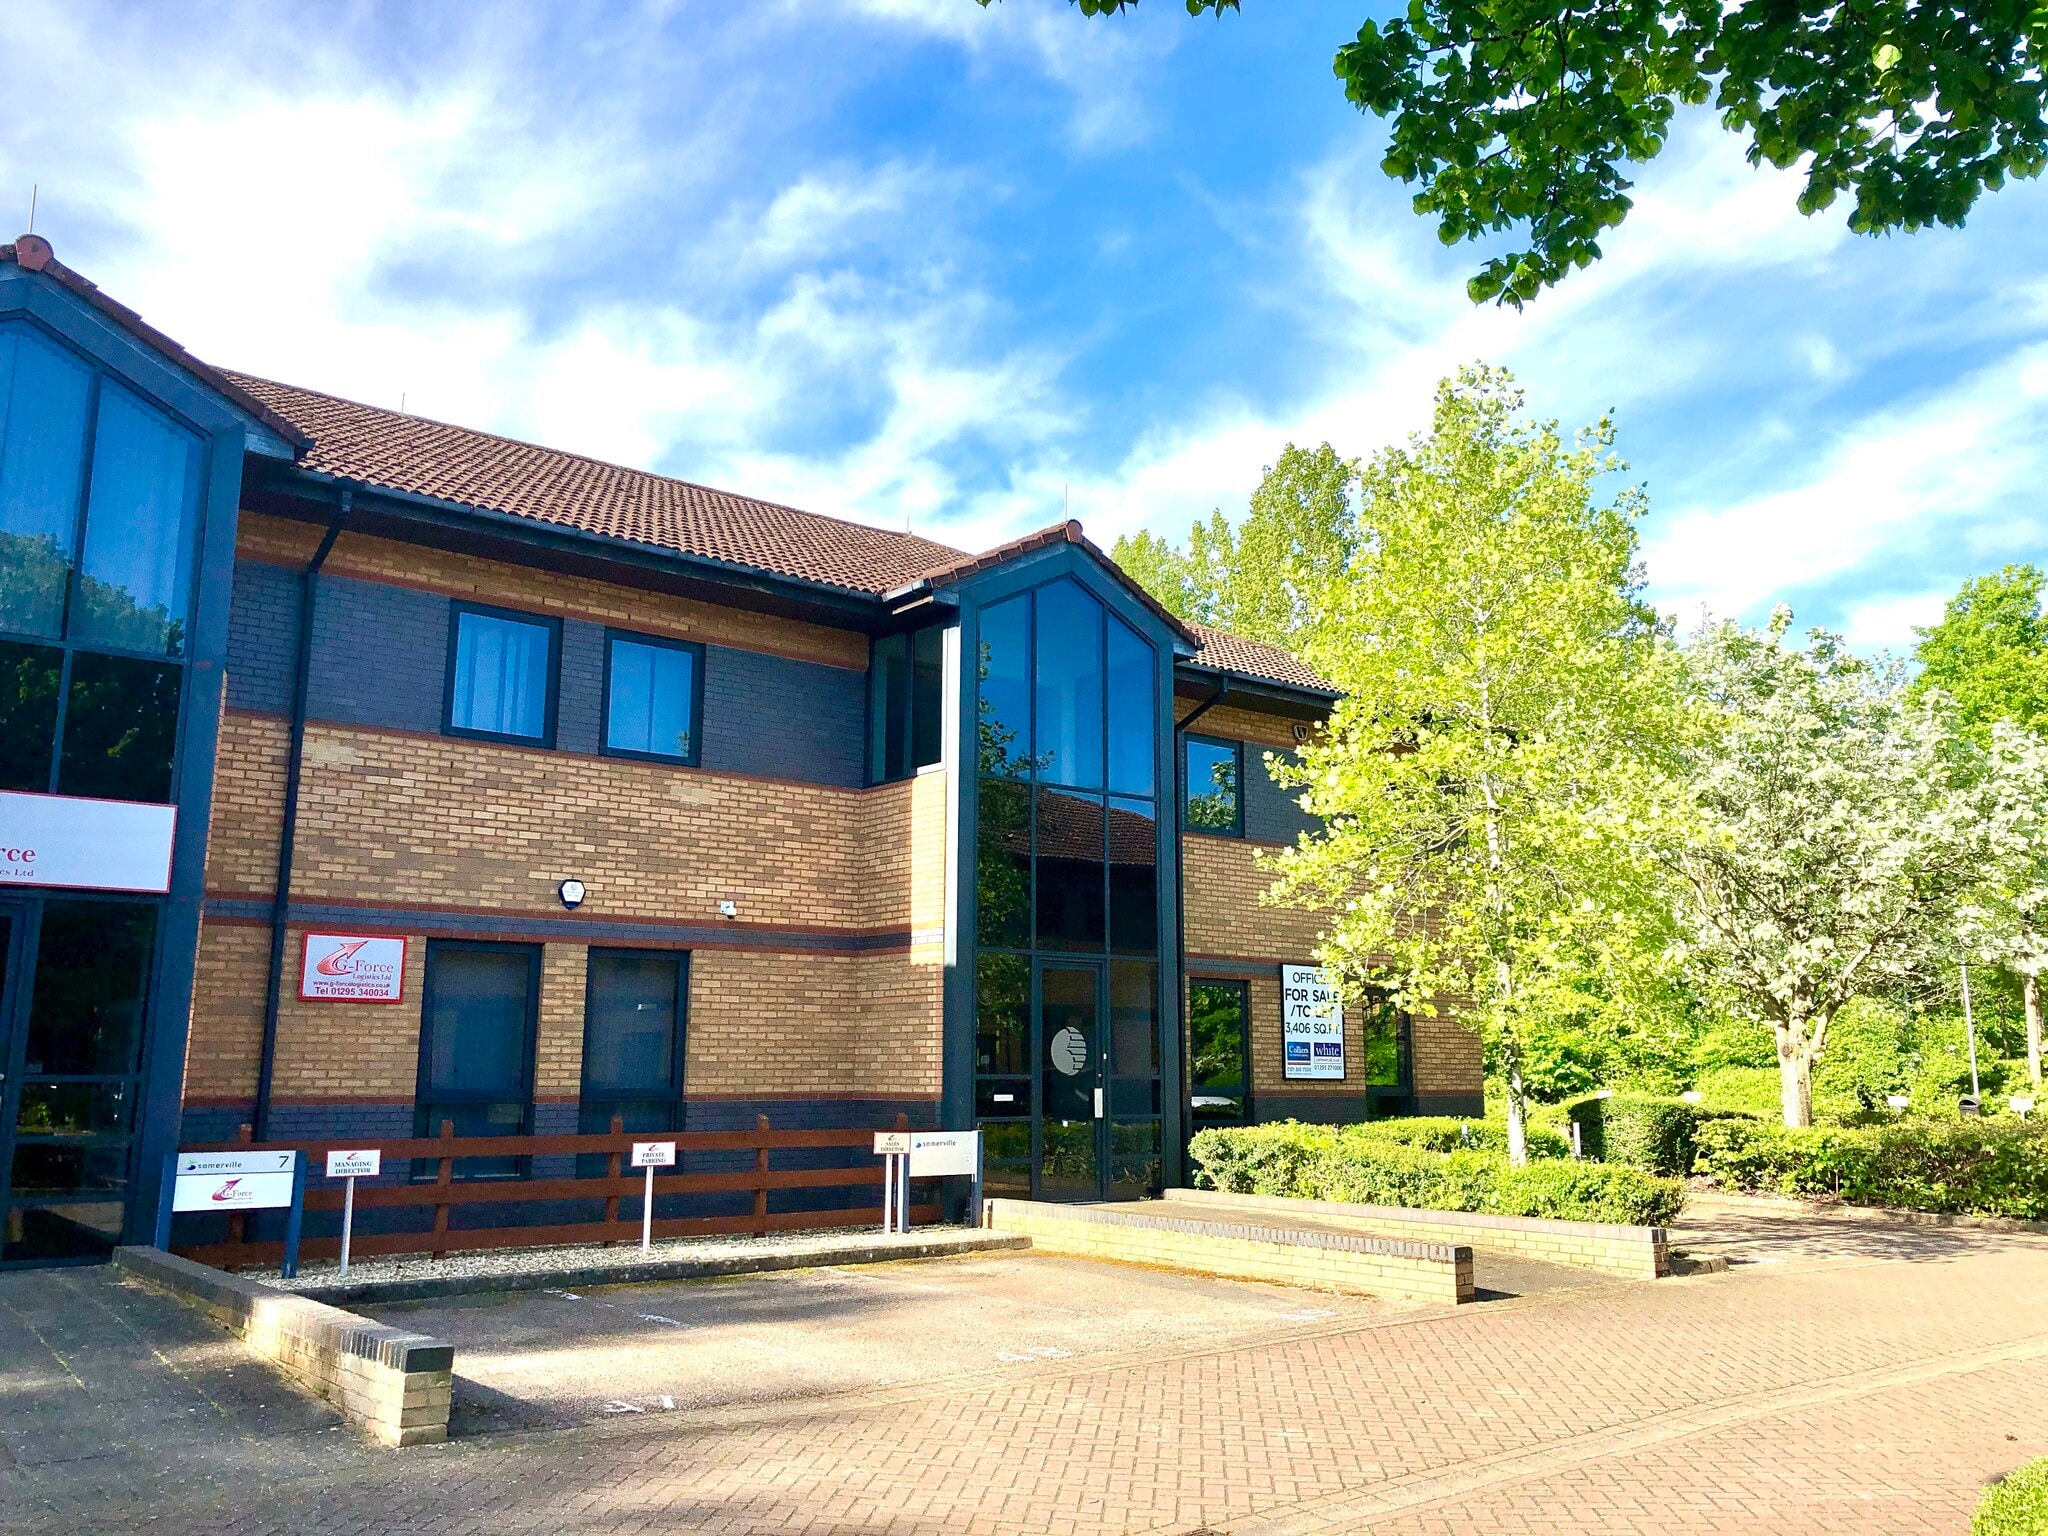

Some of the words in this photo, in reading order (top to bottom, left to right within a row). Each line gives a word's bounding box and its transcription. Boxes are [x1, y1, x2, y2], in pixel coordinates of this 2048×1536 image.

[14, 868, 34, 877] Ltd
[335, 959, 395, 974] G-Force
[352, 972, 380, 981] Logistics
[381, 973, 392, 981] Ltd
[315, 986, 328, 995] Tel
[331, 986, 356, 996] 01295
[358, 987, 390, 997] 340034
[1285, 988, 1308, 1002] FOR
[1312, 989, 1340, 1004] SALE
[1285, 1021, 1311, 1035] 3,406
[1315, 1044, 1340, 1056] white
[923, 1140, 956, 1148] somerville
[197, 1161, 242, 1169] somerville
[278, 1155, 289, 1168] 7
